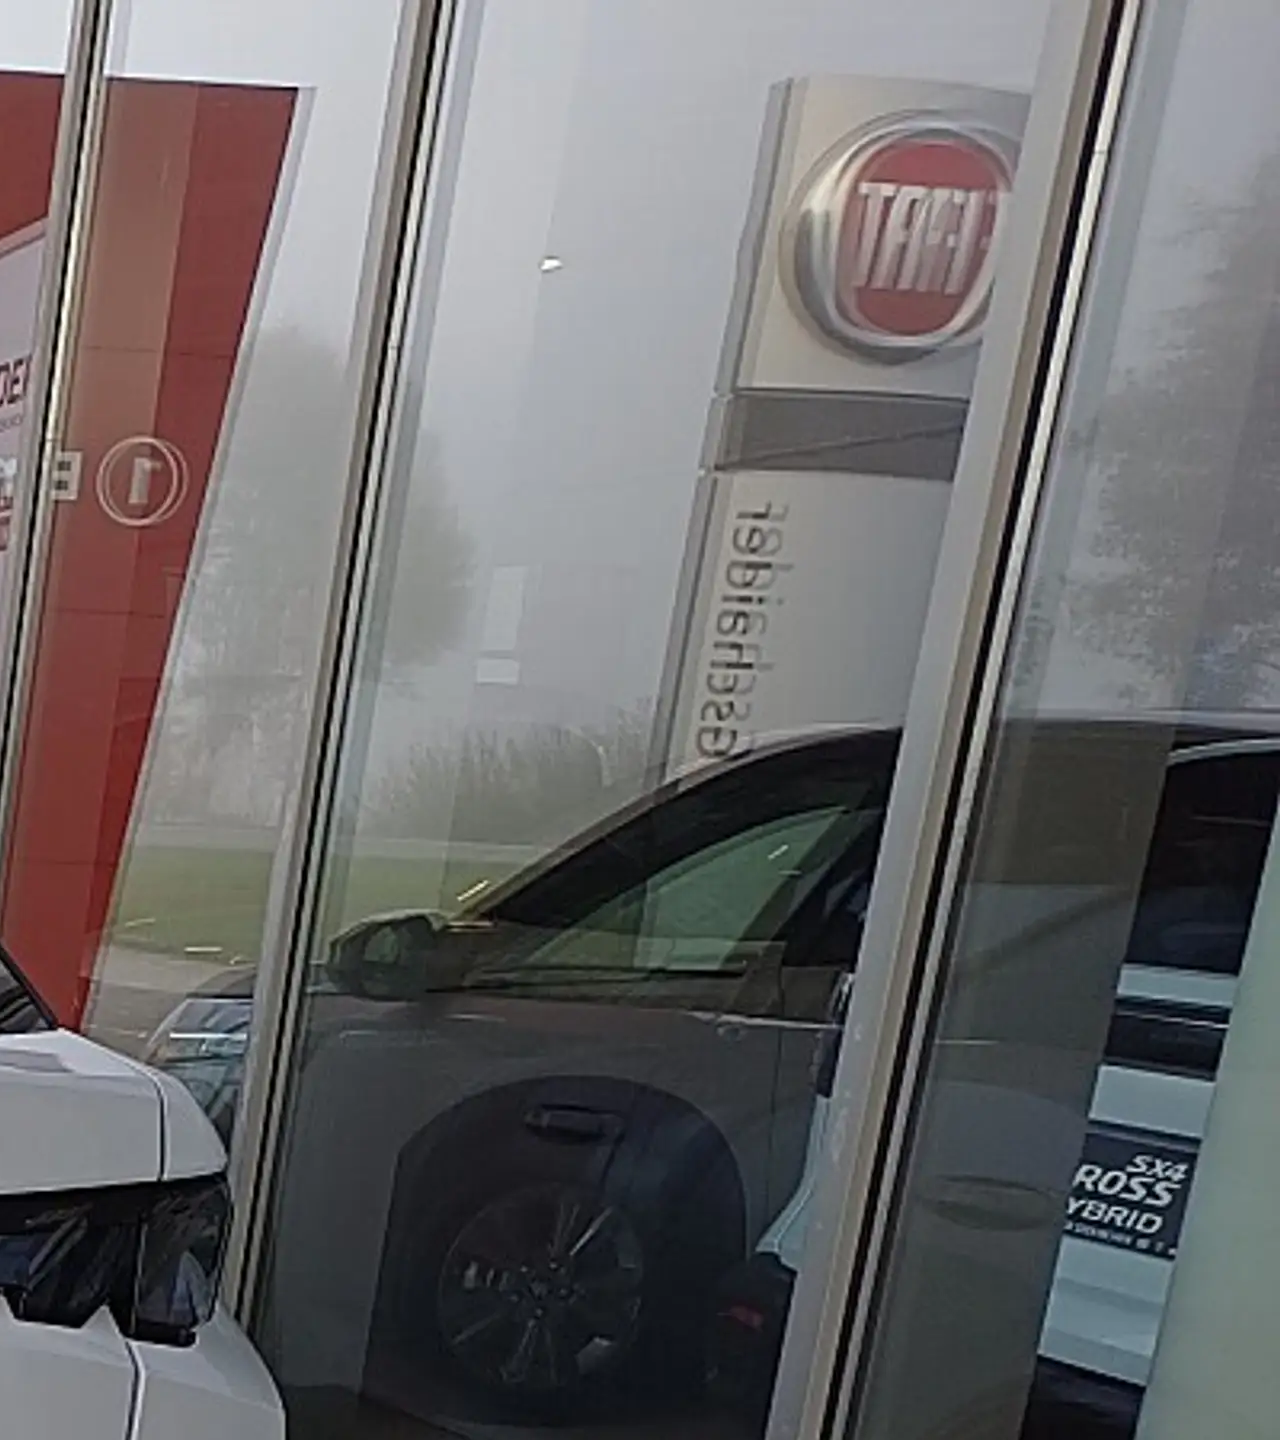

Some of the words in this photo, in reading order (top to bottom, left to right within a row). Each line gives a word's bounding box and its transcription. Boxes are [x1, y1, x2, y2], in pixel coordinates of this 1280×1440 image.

[1072, 1164, 1181, 1207] ROSS
[1126, 1155, 1188, 1181] SX4
[1066, 1197, 1163, 1234] YBRID
